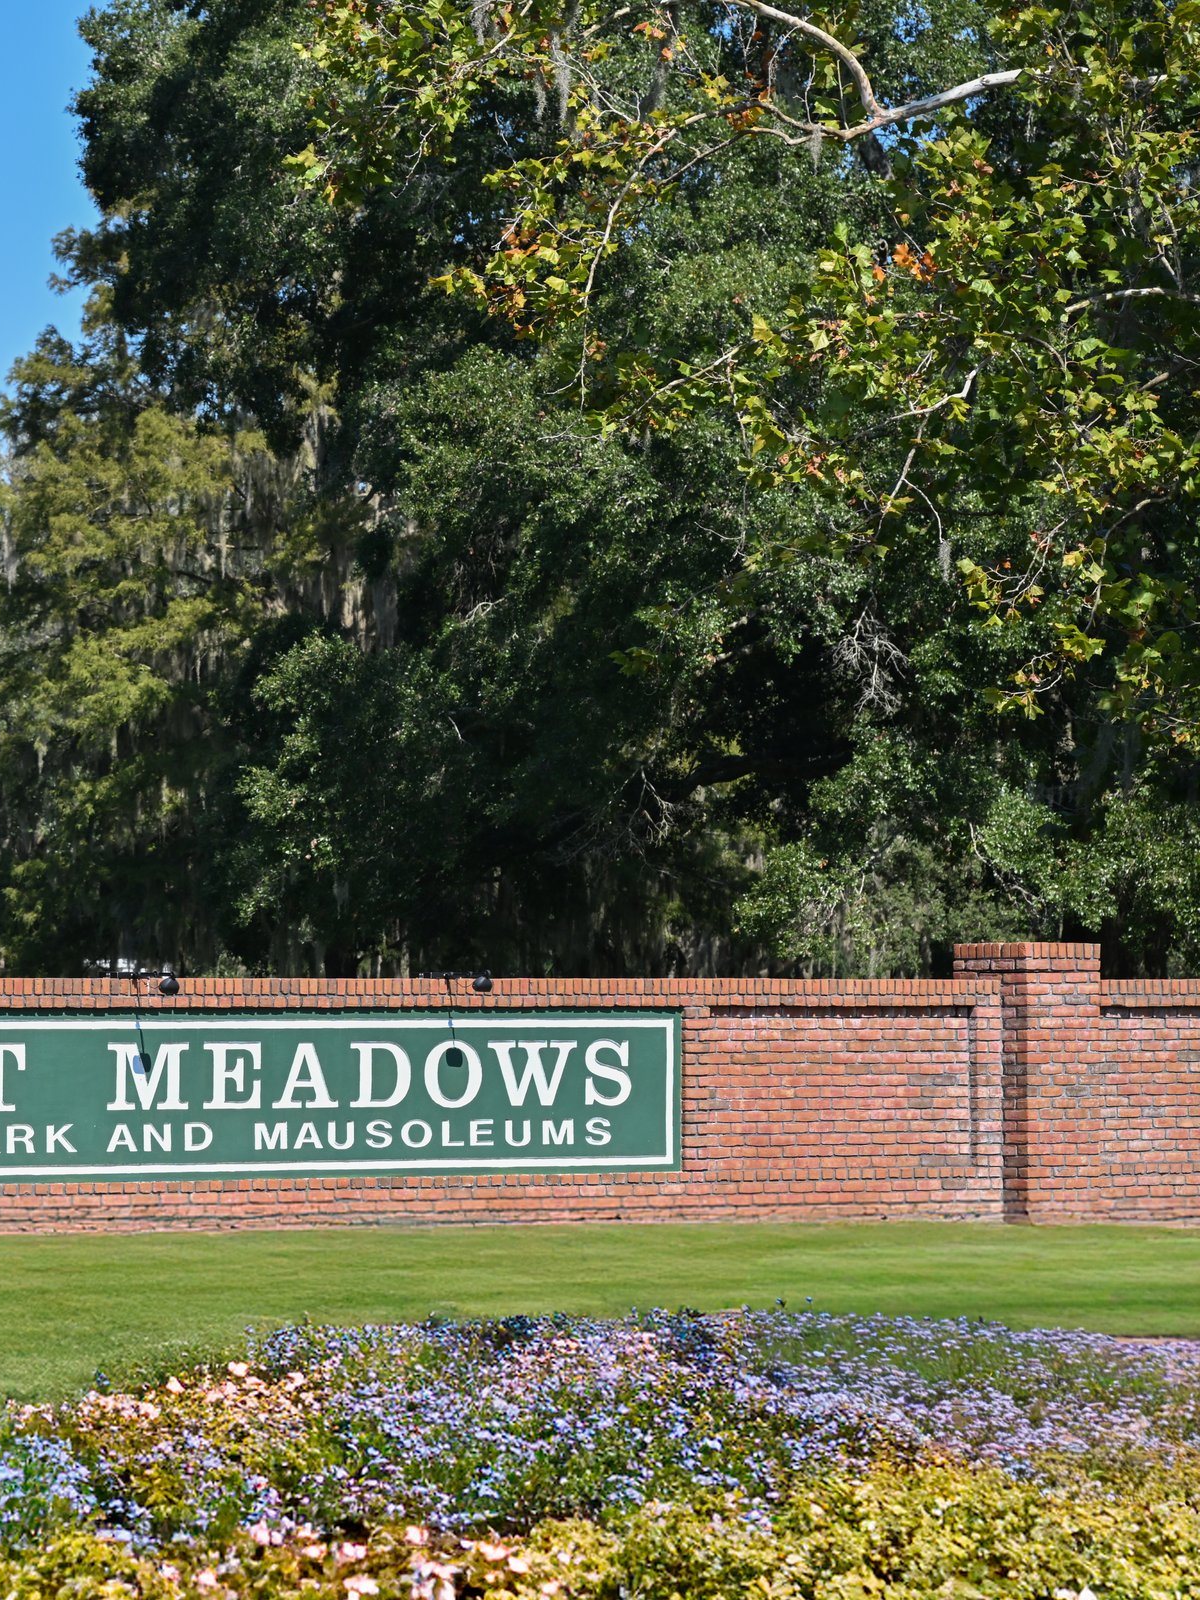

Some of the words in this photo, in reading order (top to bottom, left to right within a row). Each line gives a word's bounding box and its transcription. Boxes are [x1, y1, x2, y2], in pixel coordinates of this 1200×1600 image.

[106, 1039, 632, 1111] MEADOWS
[106, 1121, 214, 1153] AND
[254, 1116, 612, 1151] MAUSOLEUMS
